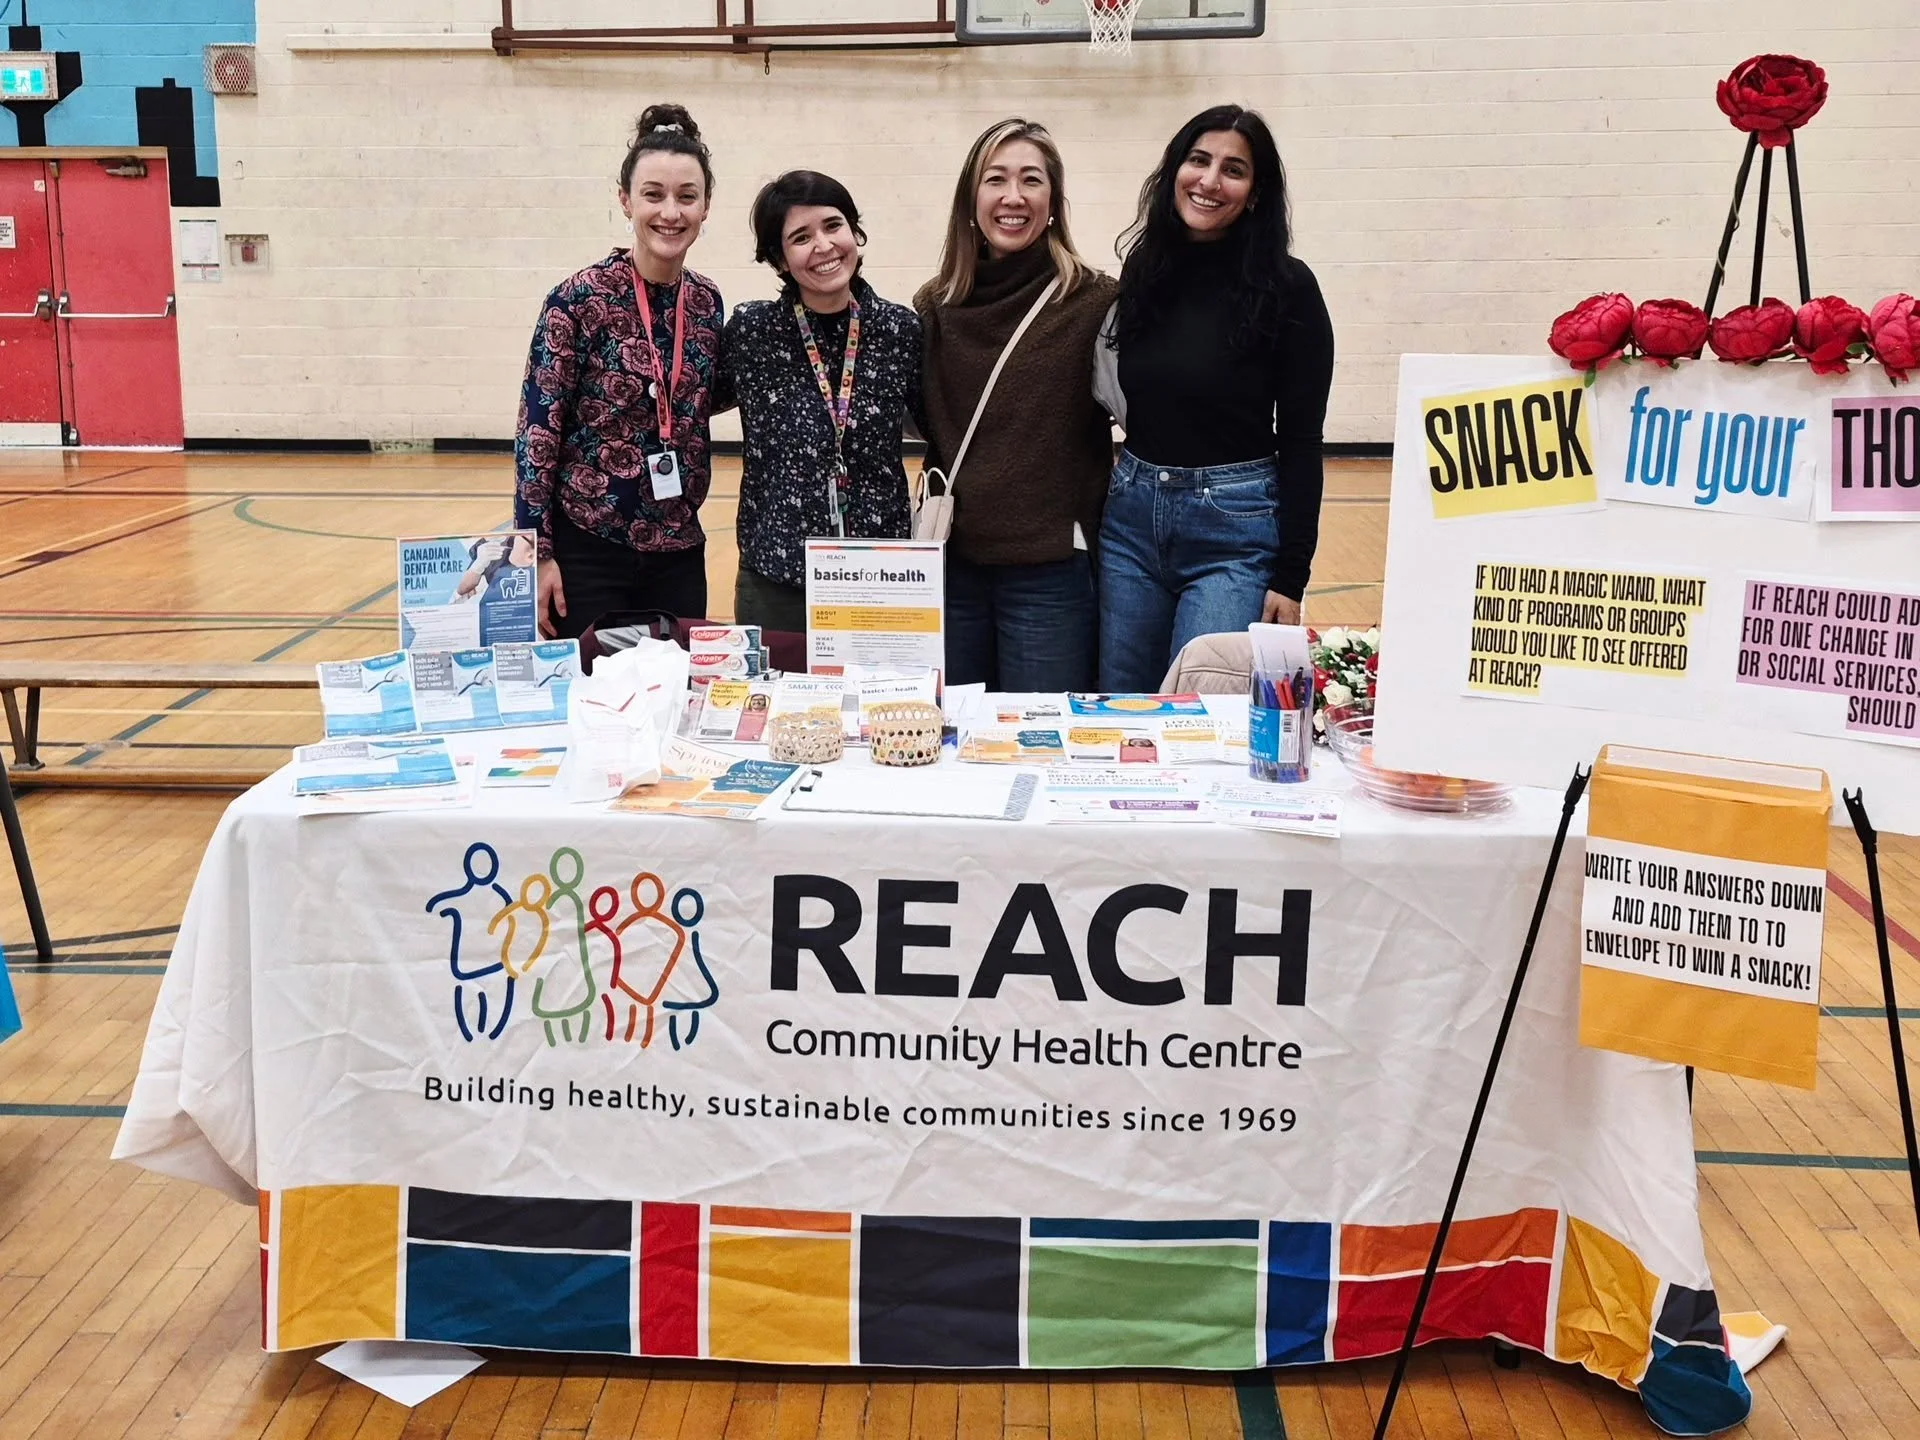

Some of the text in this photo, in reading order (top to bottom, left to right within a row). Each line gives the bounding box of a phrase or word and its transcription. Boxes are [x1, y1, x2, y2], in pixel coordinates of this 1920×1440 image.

[1425, 388, 1593, 494] SNACK
[1625, 386, 1692, 487] for
[1694, 411, 1806, 505] your
[403, 547, 450, 562] CANADIAN
[404, 560, 464, 576] DENTAL CARE
[404, 577, 428, 591] PLAN
[1475, 564, 1707, 607] IF YOU HAD A MAGIC WAND, WHAT
[1752, 584, 1768, 612] IF
[1773, 586, 1830, 618] REACH
[1835, 592, 1892, 624] COULD
[691, 630, 725, 639] Colgate
[1473, 595, 1687, 638] KIND OF PROGRAMS OR GROUPS
[690, 654, 724, 663] Colgate
[1471, 626, 1688, 671] WOULD YOU LIKE TO SEE OFFERED
[1741, 616, 1915, 661] FOR ONE CHANGE IN
[1468, 657, 1542, 689] AT REACH?
[1737, 649, 1761, 678] OR
[1766, 652, 1826, 685] SOCIAL
[1848, 696, 1917, 730] SHOULD
[1585, 851, 1823, 914] WRITE YOUR ANSWERS DOWN
[770, 874, 1312, 1006] REACH
[1612, 895, 1786, 948] AND ADD THEM TO TO
[1586, 929, 1812, 991] ENVELOPE TO WIN A SNACK!
[766, 1020, 1302, 1070] Community Health Centre
[424, 1076, 1298, 1132] Building healthy, sustainable communities since 1969
